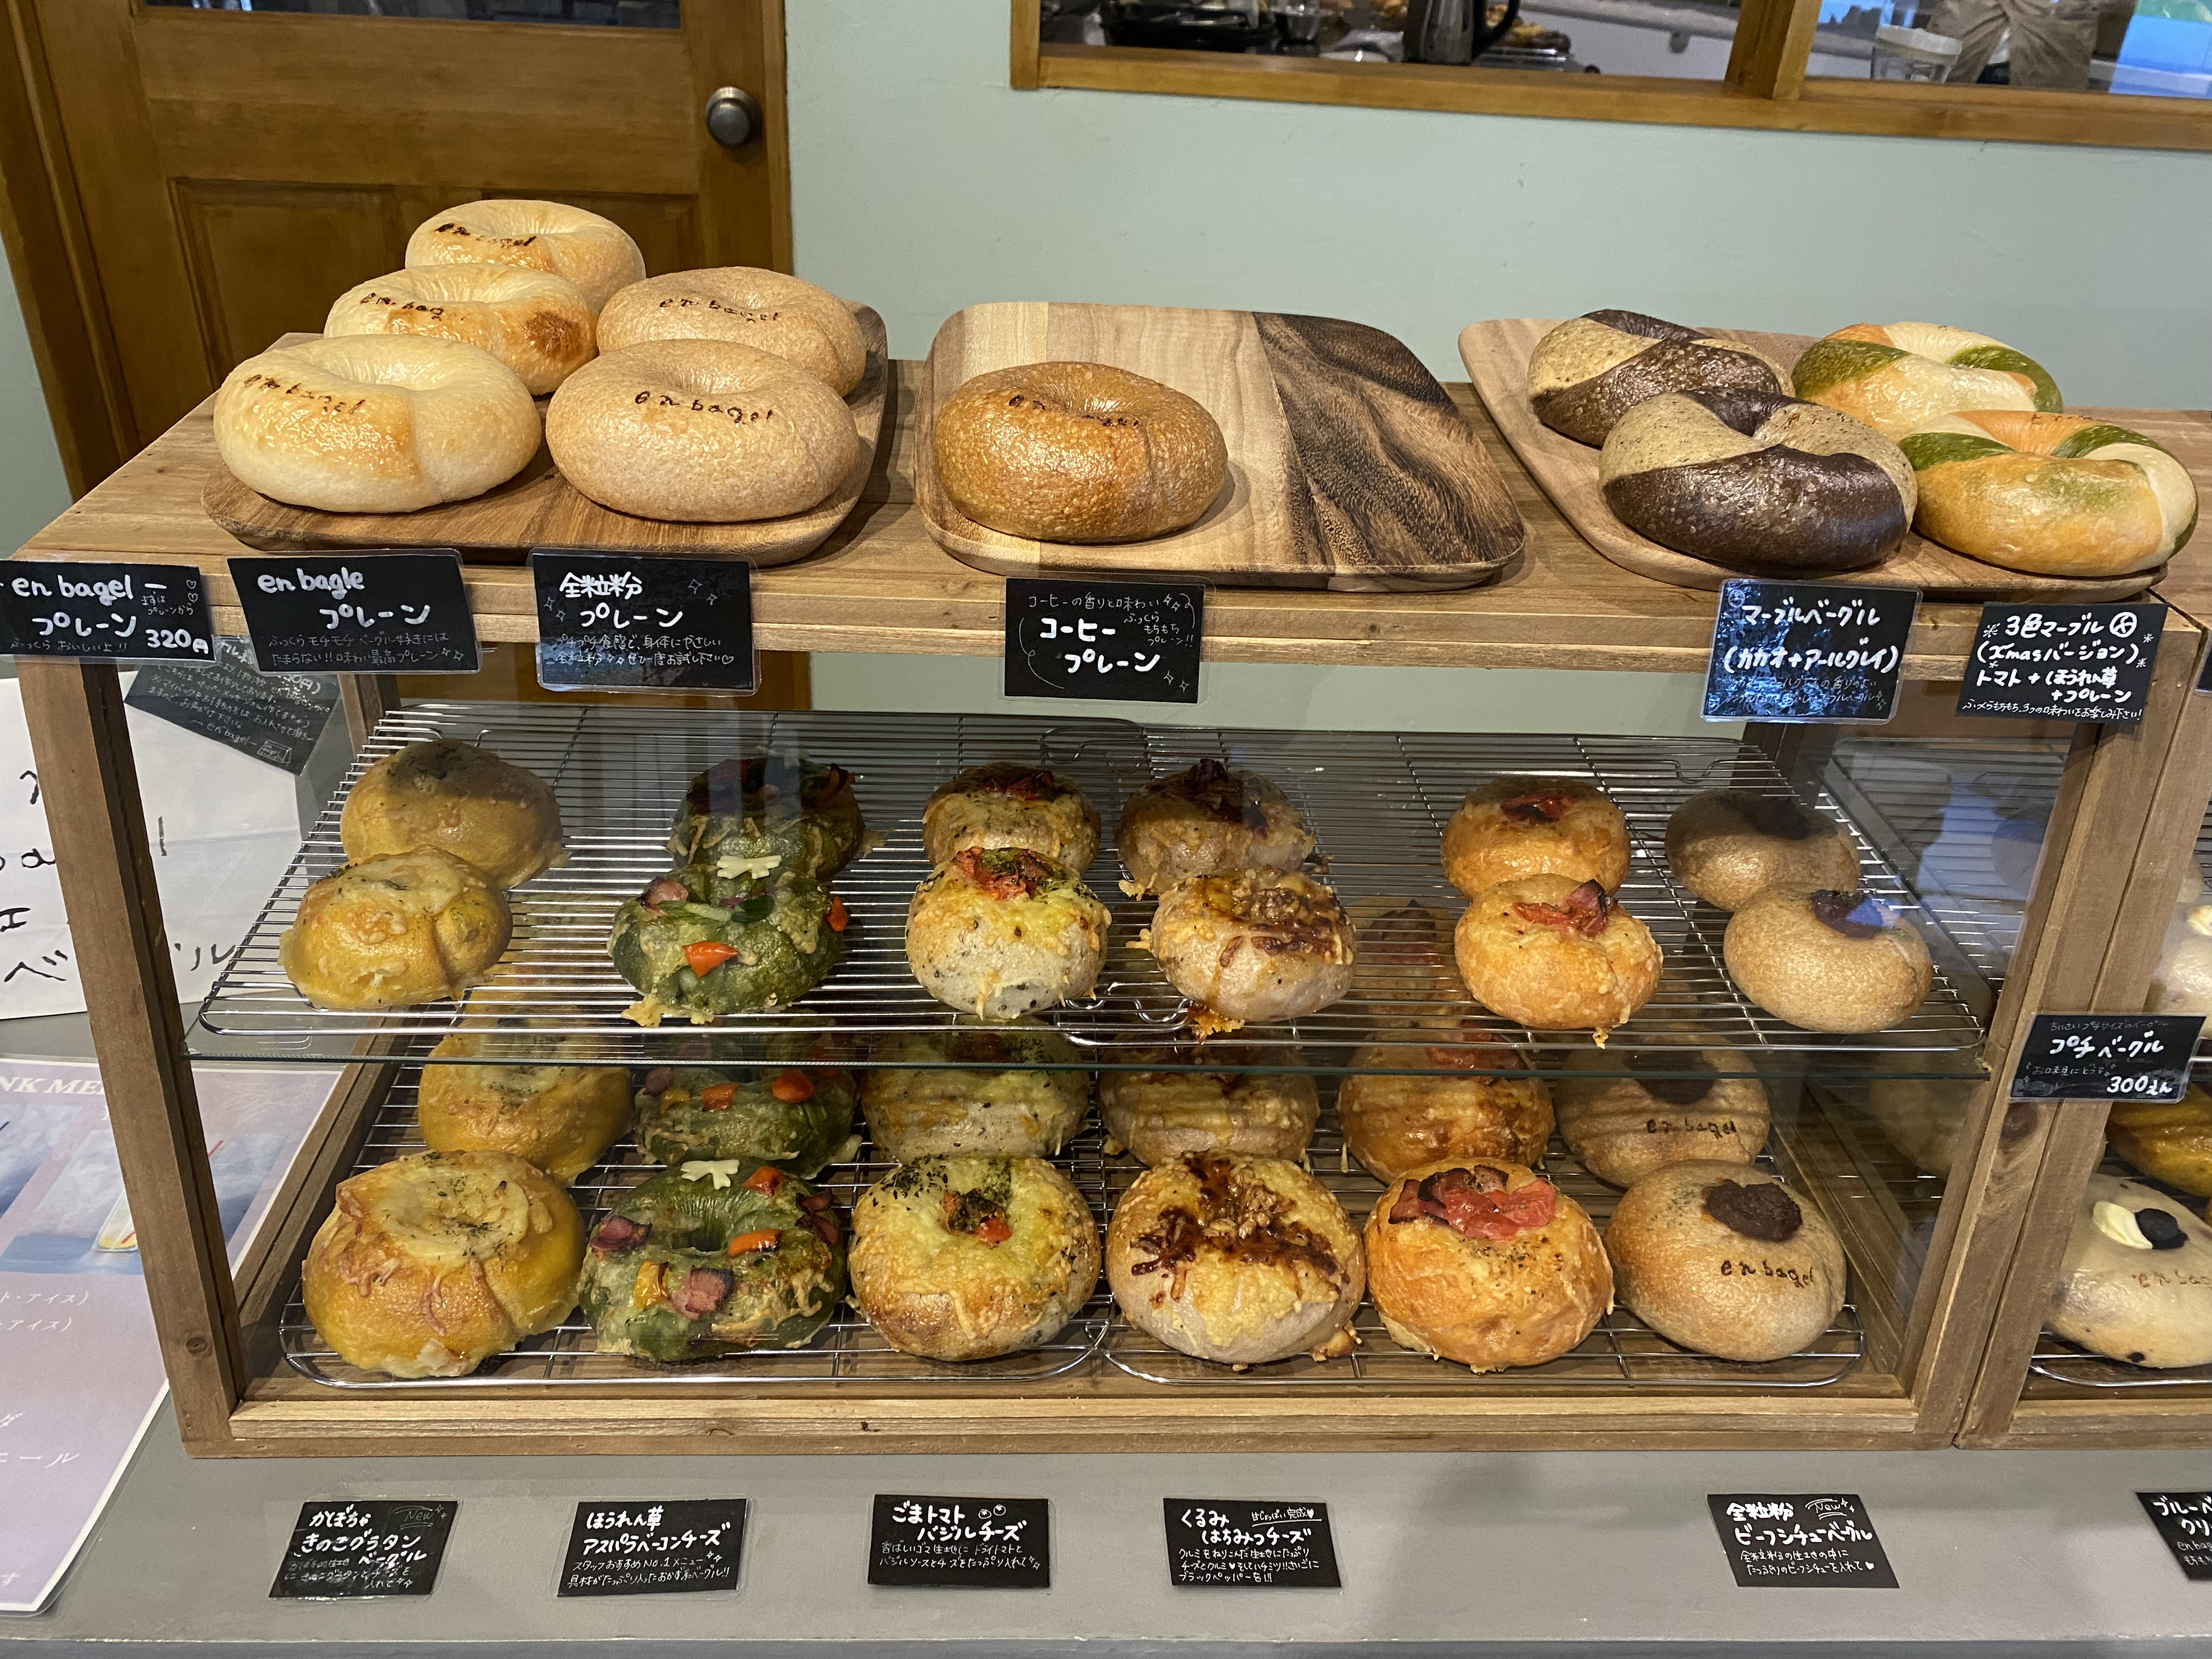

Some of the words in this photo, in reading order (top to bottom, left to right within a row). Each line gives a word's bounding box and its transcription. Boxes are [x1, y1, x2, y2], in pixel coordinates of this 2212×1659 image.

[659, 298, 698, 308] en
[635, 391, 680, 405] en
[691, 399, 772, 425] bagel
[12, 578, 52, 597] en
[58, 574, 133, 606] bagel
[257, 574, 296, 594] en
[297, 567, 365, 600] bagle
[559, 571, 642, 600] 全粒粉
[1028, 591, 1159, 612] コーヒーの香りと味わい
[1741, 596, 1881, 627] マーブルベーグル
[32, 612, 137, 637] プレーン
[319, 603, 431, 629] プレーン
[580, 602, 684, 629] プレーン
[2005, 612, 2104, 638] 3色マーブル
[1040, 618, 1116, 642] コーヒー
[1144, 623, 1180, 635] もちもち
[1064, 648, 1161, 674] プレーン
[1977, 669, 2021, 687] トマト
[2098, 1030, 2164, 1058] ベーグル
[43, 1079, 105, 1094] ME
[2107, 1075, 2172, 1096] 300えん
[1720, 1260, 1756, 1276] en
[309, 1504, 371, 1527] かぼちゃ
[404, 1510, 434, 1522] New
[586, 1505, 664, 1531] ほうれん草
[1181, 1509, 1229, 1528] くるみ
[1726, 1502, 1794, 1521] 全粒粉
[1815, 1503, 1841, 1513] New
[301, 1528, 421, 1553] きのこグラタン
[583, 1521, 731, 1555] アスパラベーコンチーズ
[917, 1520, 1027, 1542] バジルチーズ
[1201, 1526, 1312, 1545] はちみつチーズ
[1735, 1520, 1873, 1546] ビーフシチューベーグル
[358, 1550, 427, 1568] ベーグル
